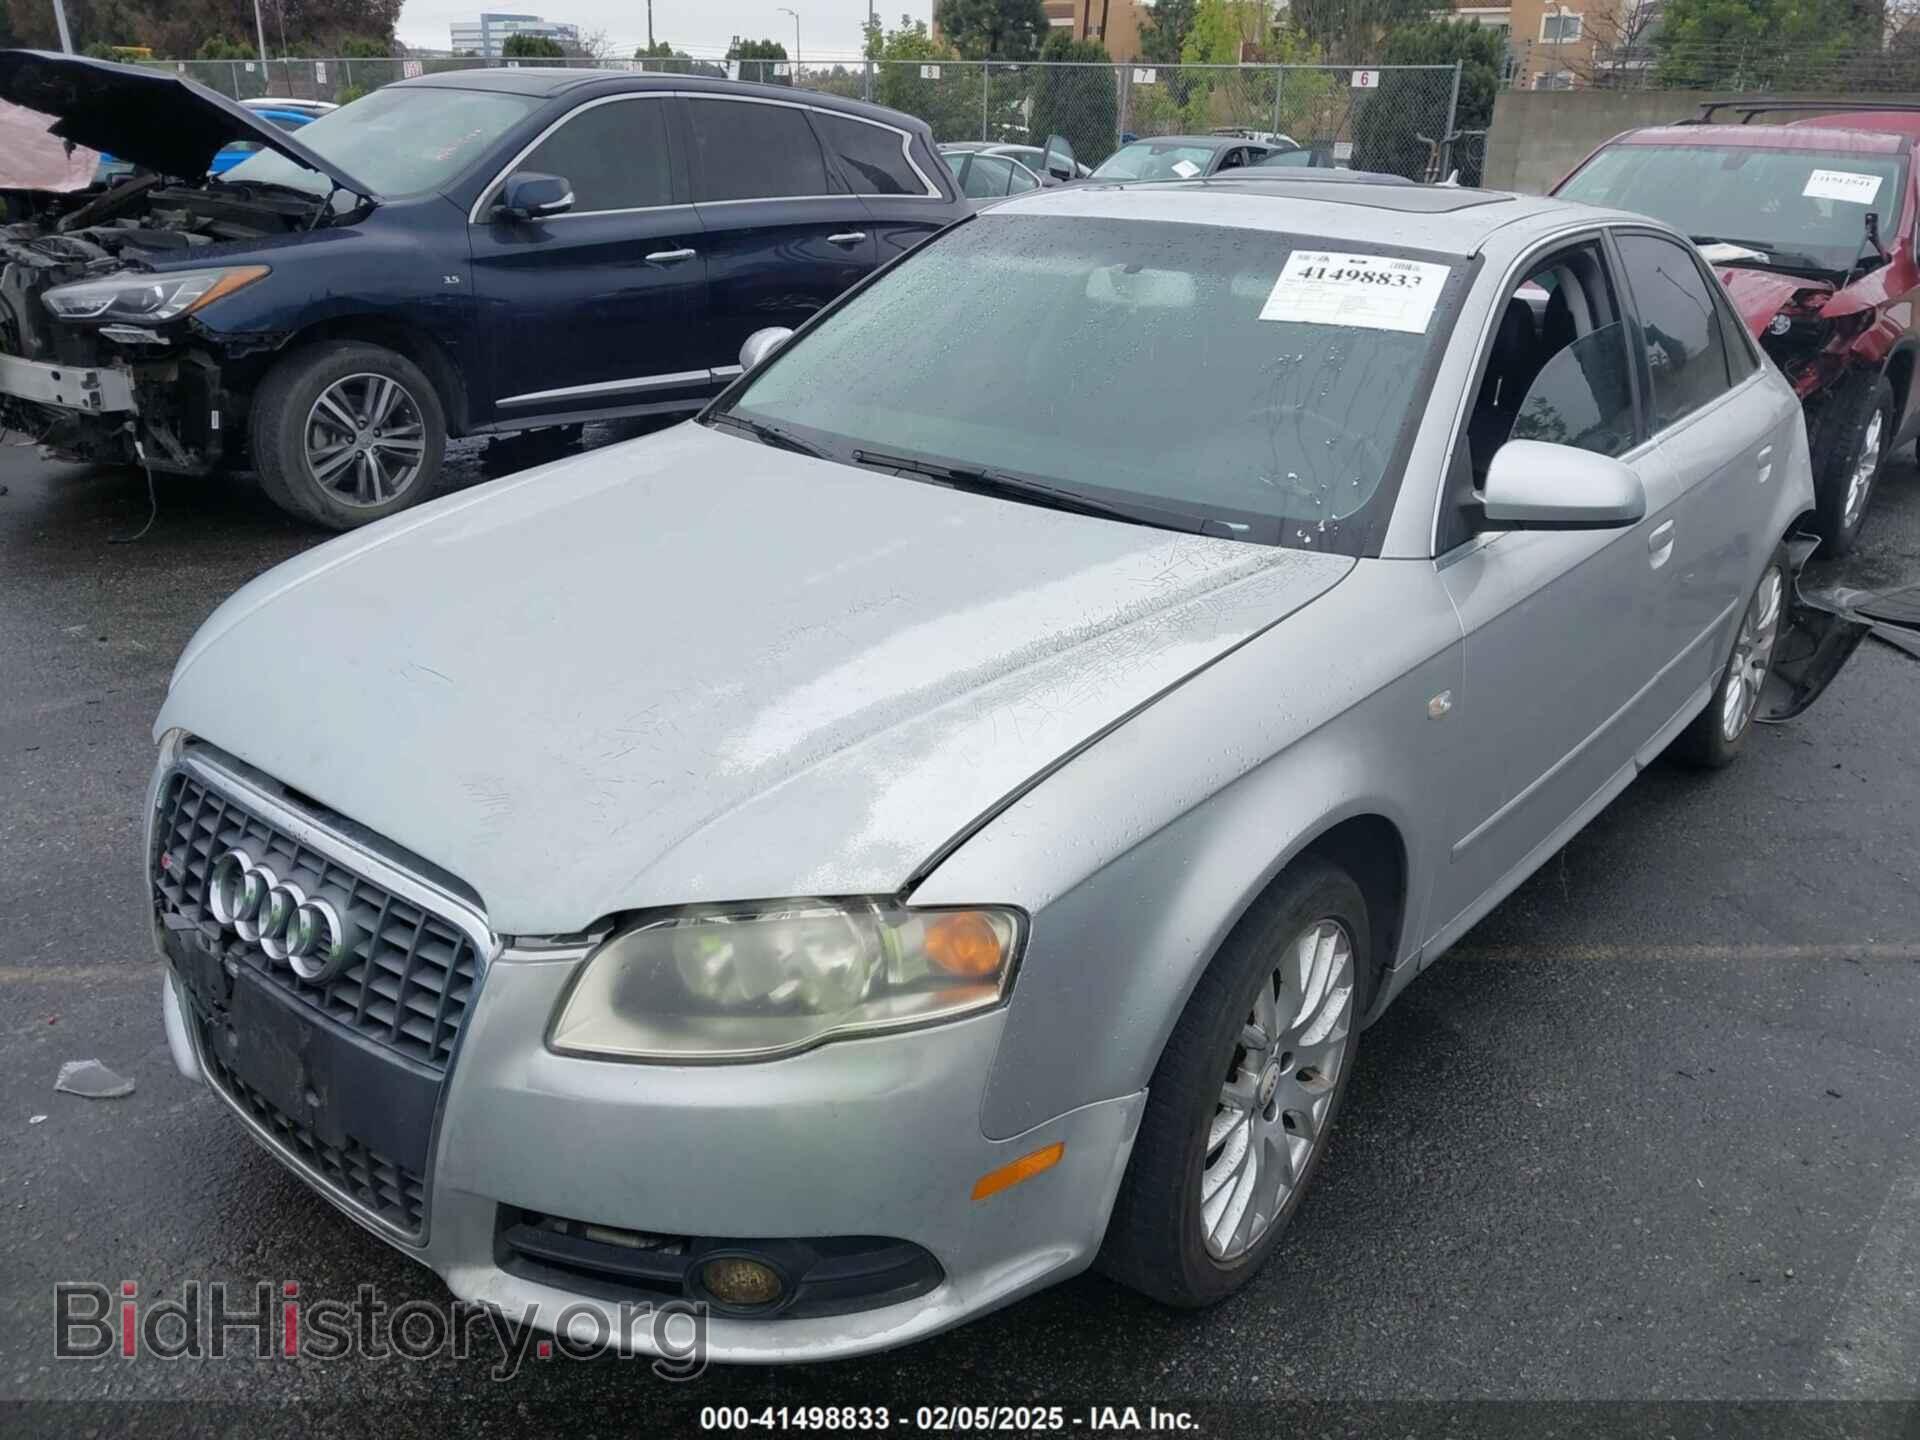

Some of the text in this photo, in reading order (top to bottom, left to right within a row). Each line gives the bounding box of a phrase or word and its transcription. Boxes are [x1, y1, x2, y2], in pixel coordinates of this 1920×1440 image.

[928, 65, 934, 79] 8
[1142, 69, 1149, 82] 7
[1361, 72, 1369, 86] 6
[1297, 265, 1421, 288] 41498833
